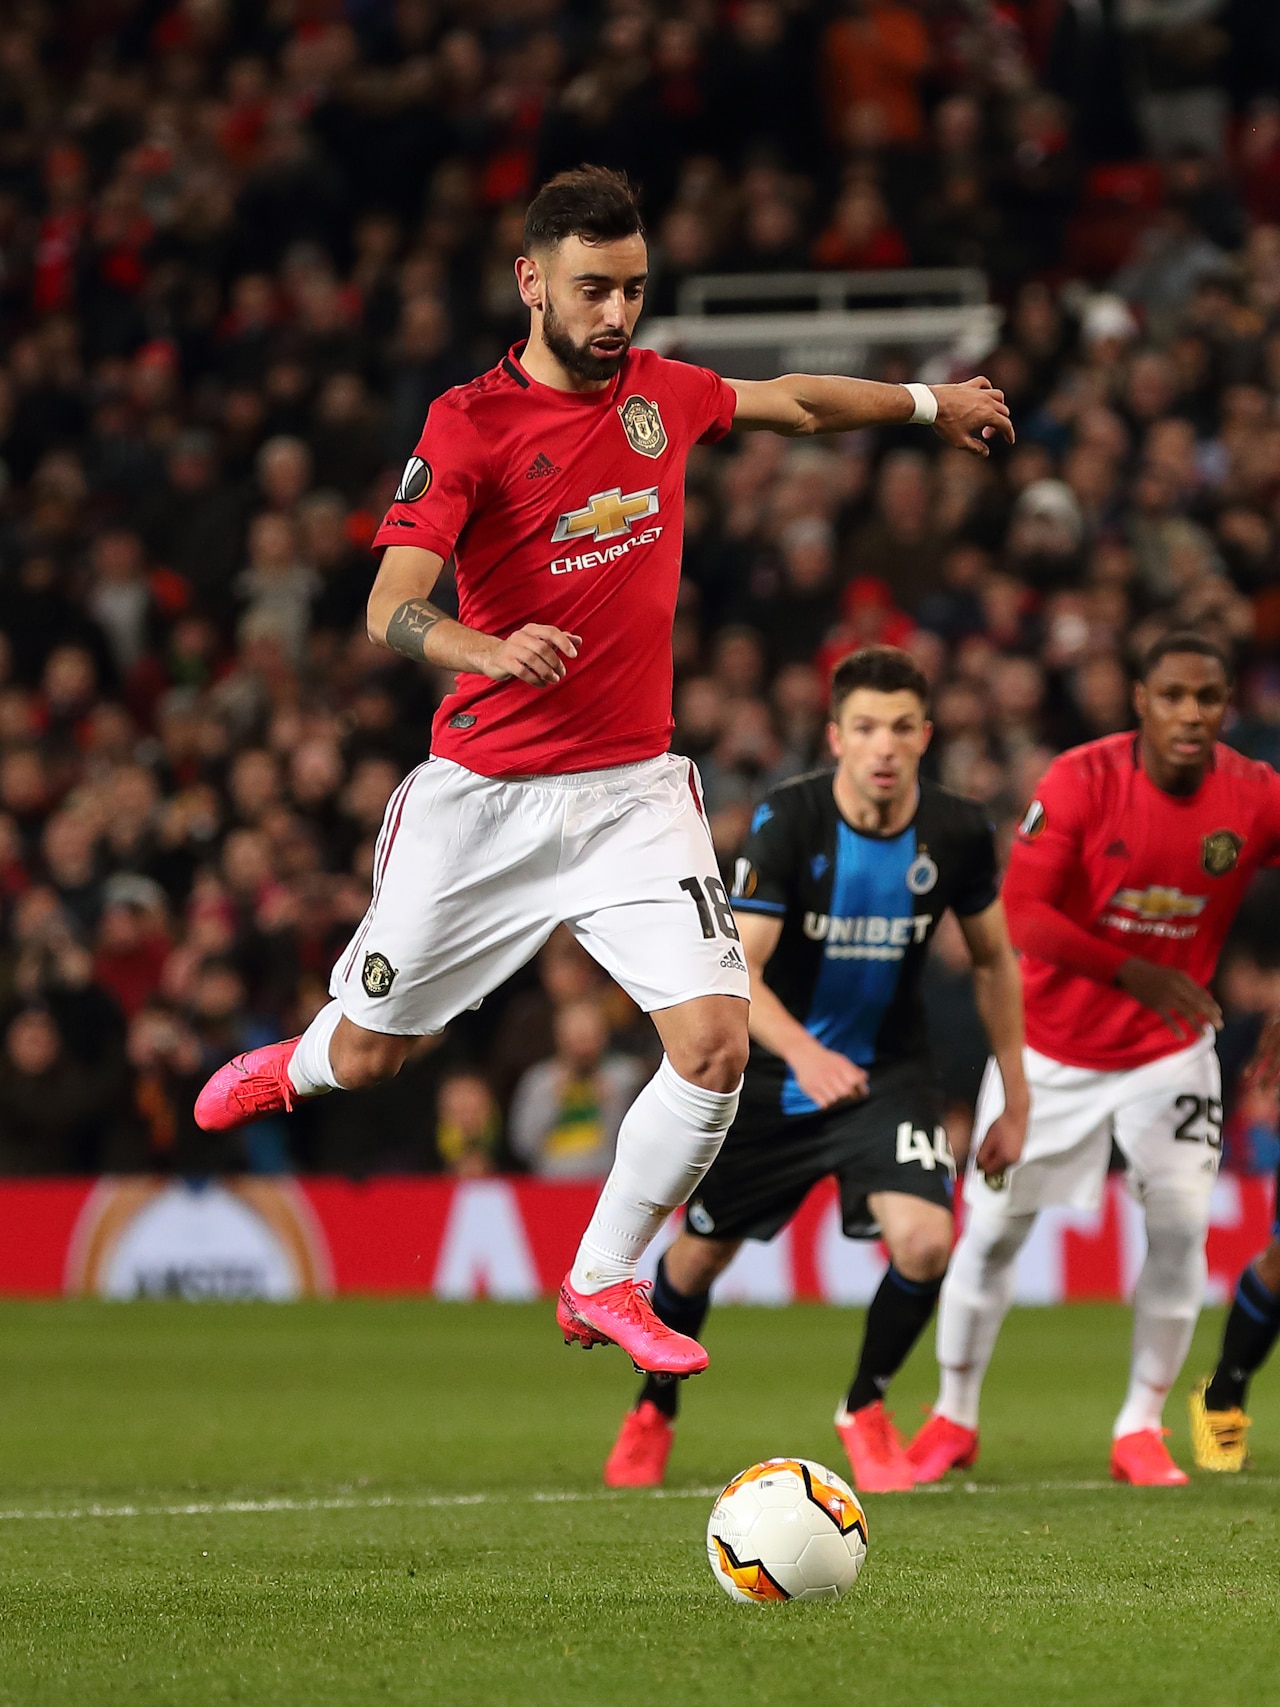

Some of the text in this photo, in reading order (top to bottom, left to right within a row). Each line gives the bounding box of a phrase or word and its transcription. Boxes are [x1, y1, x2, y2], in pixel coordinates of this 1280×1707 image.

[678, 875, 740, 942] 18
[802, 911, 934, 945] UNIBET
[1175, 1095, 1223, 1149] 25
